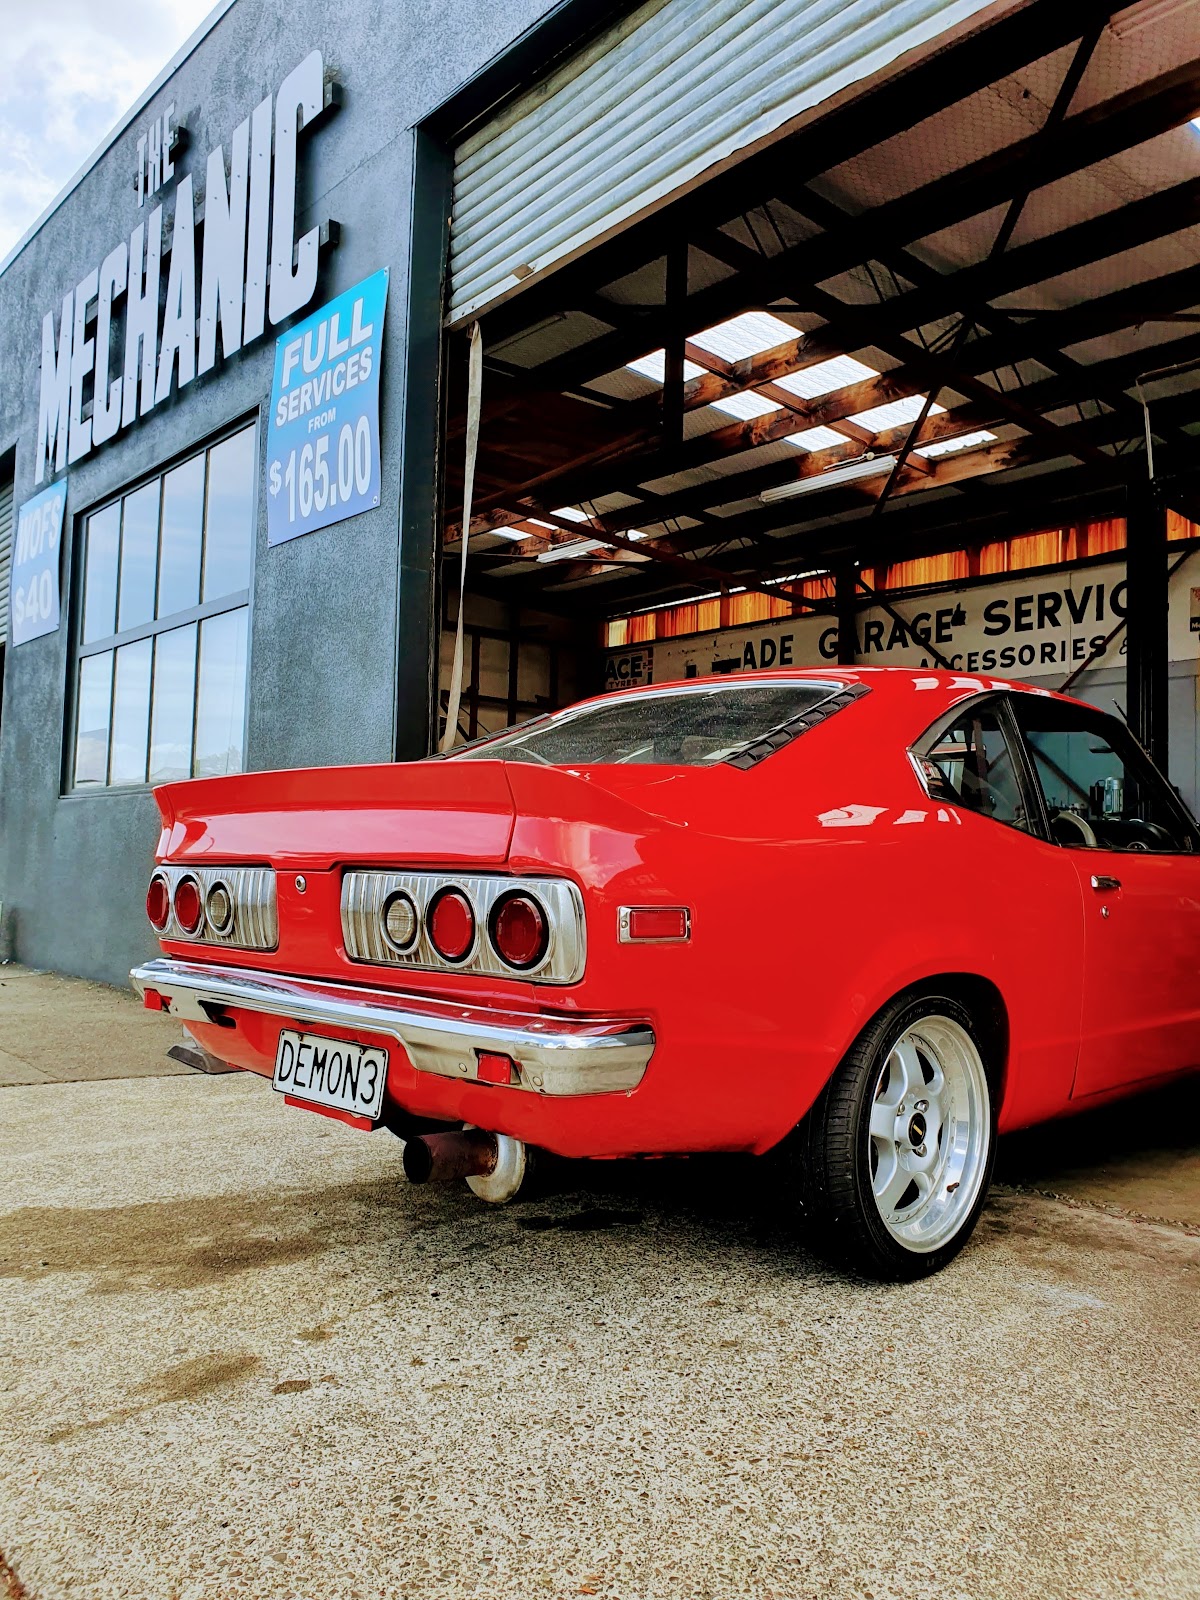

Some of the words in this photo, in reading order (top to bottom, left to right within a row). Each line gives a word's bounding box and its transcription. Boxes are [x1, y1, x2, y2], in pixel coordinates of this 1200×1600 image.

[136, 103, 175, 208] THE
[35, 50, 324, 485] MECHANIC
[281, 298, 373, 389] FULL
[275, 346, 373, 427] SERVICES
[307, 406, 337, 434] FROM
[269, 415, 372, 523] $165.00
[17, 495, 63, 567] WOFS
[15, 568, 53, 625] $40
[983, 579, 1127, 636] SERVIC
[608, 678, 638, 688] TYRES
[278, 1039, 378, 1105] DEMON3
